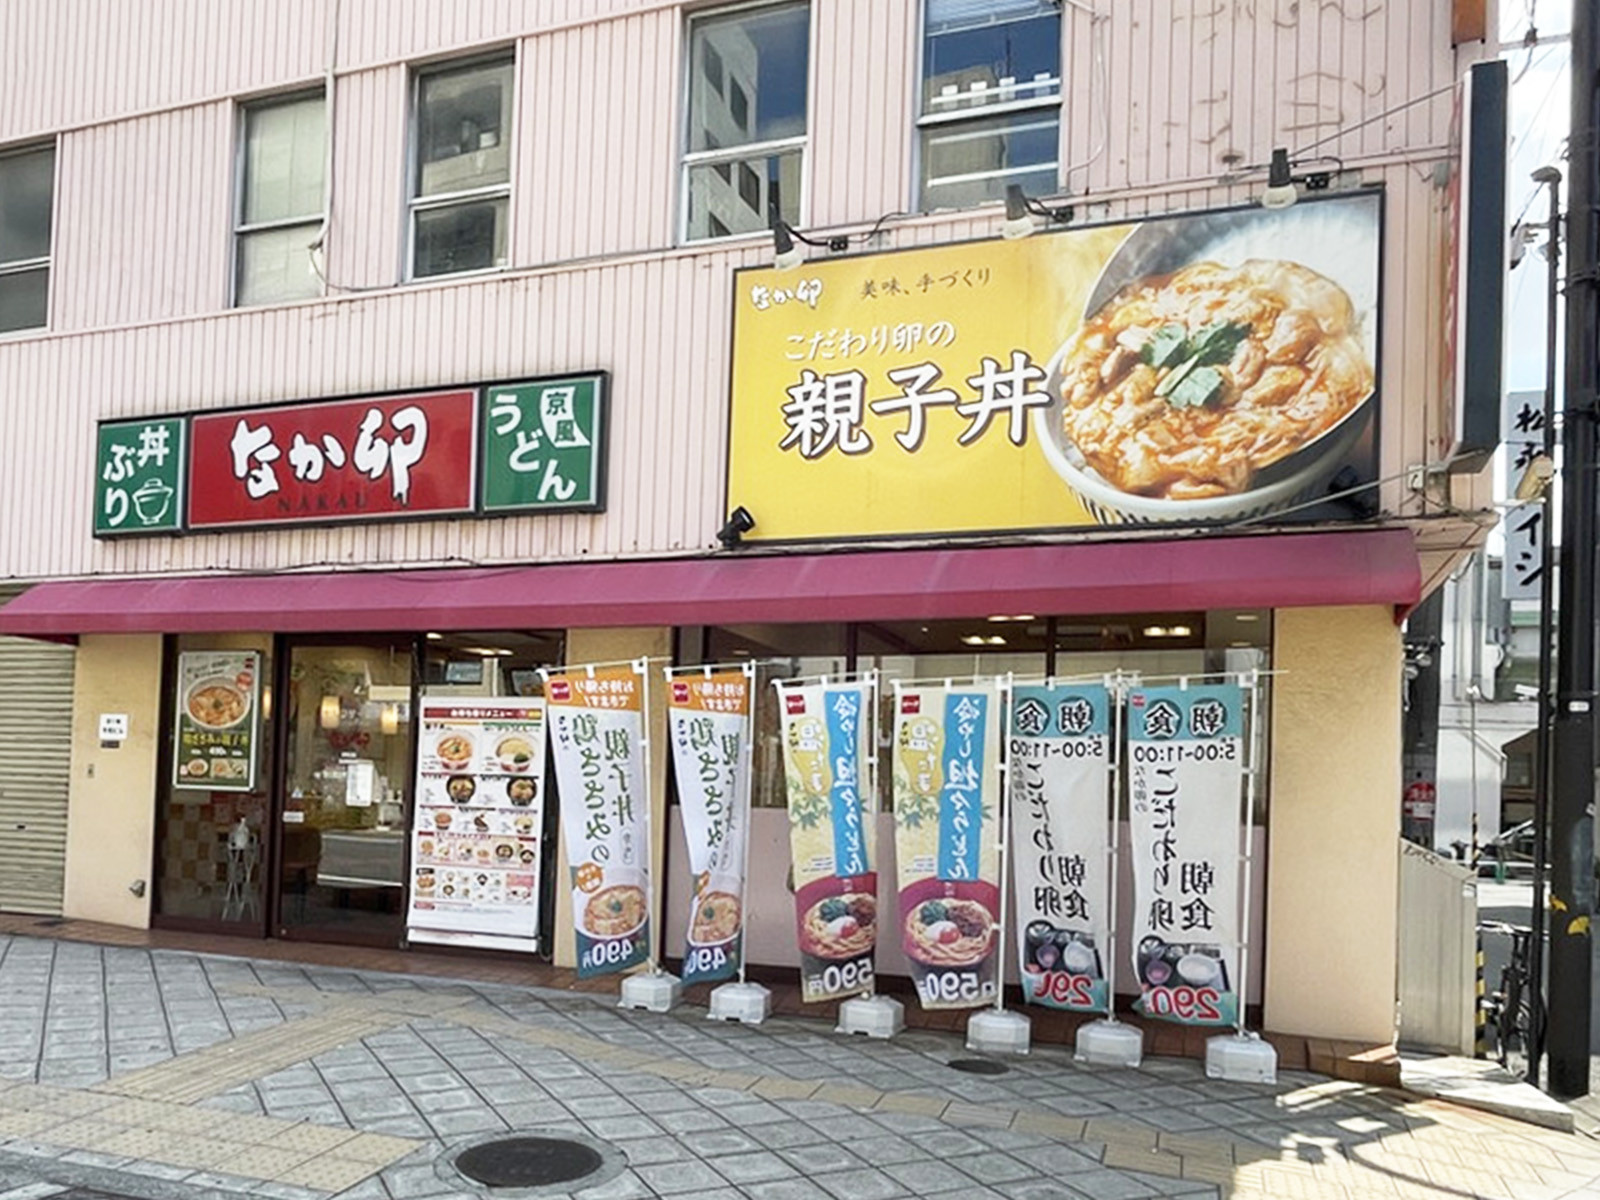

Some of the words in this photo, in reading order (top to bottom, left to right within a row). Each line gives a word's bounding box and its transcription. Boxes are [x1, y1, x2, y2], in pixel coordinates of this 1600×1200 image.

[750, 279, 823, 311] なか卯
[860, 267, 991, 300] 美味、手づくり
[546, 392, 576, 442] 京風
[778, 350, 1053, 460] 親子丼
[231, 406, 428, 506] なか卯
[491, 393, 577, 502] うどん
[277, 491, 368, 510] NAKAU
